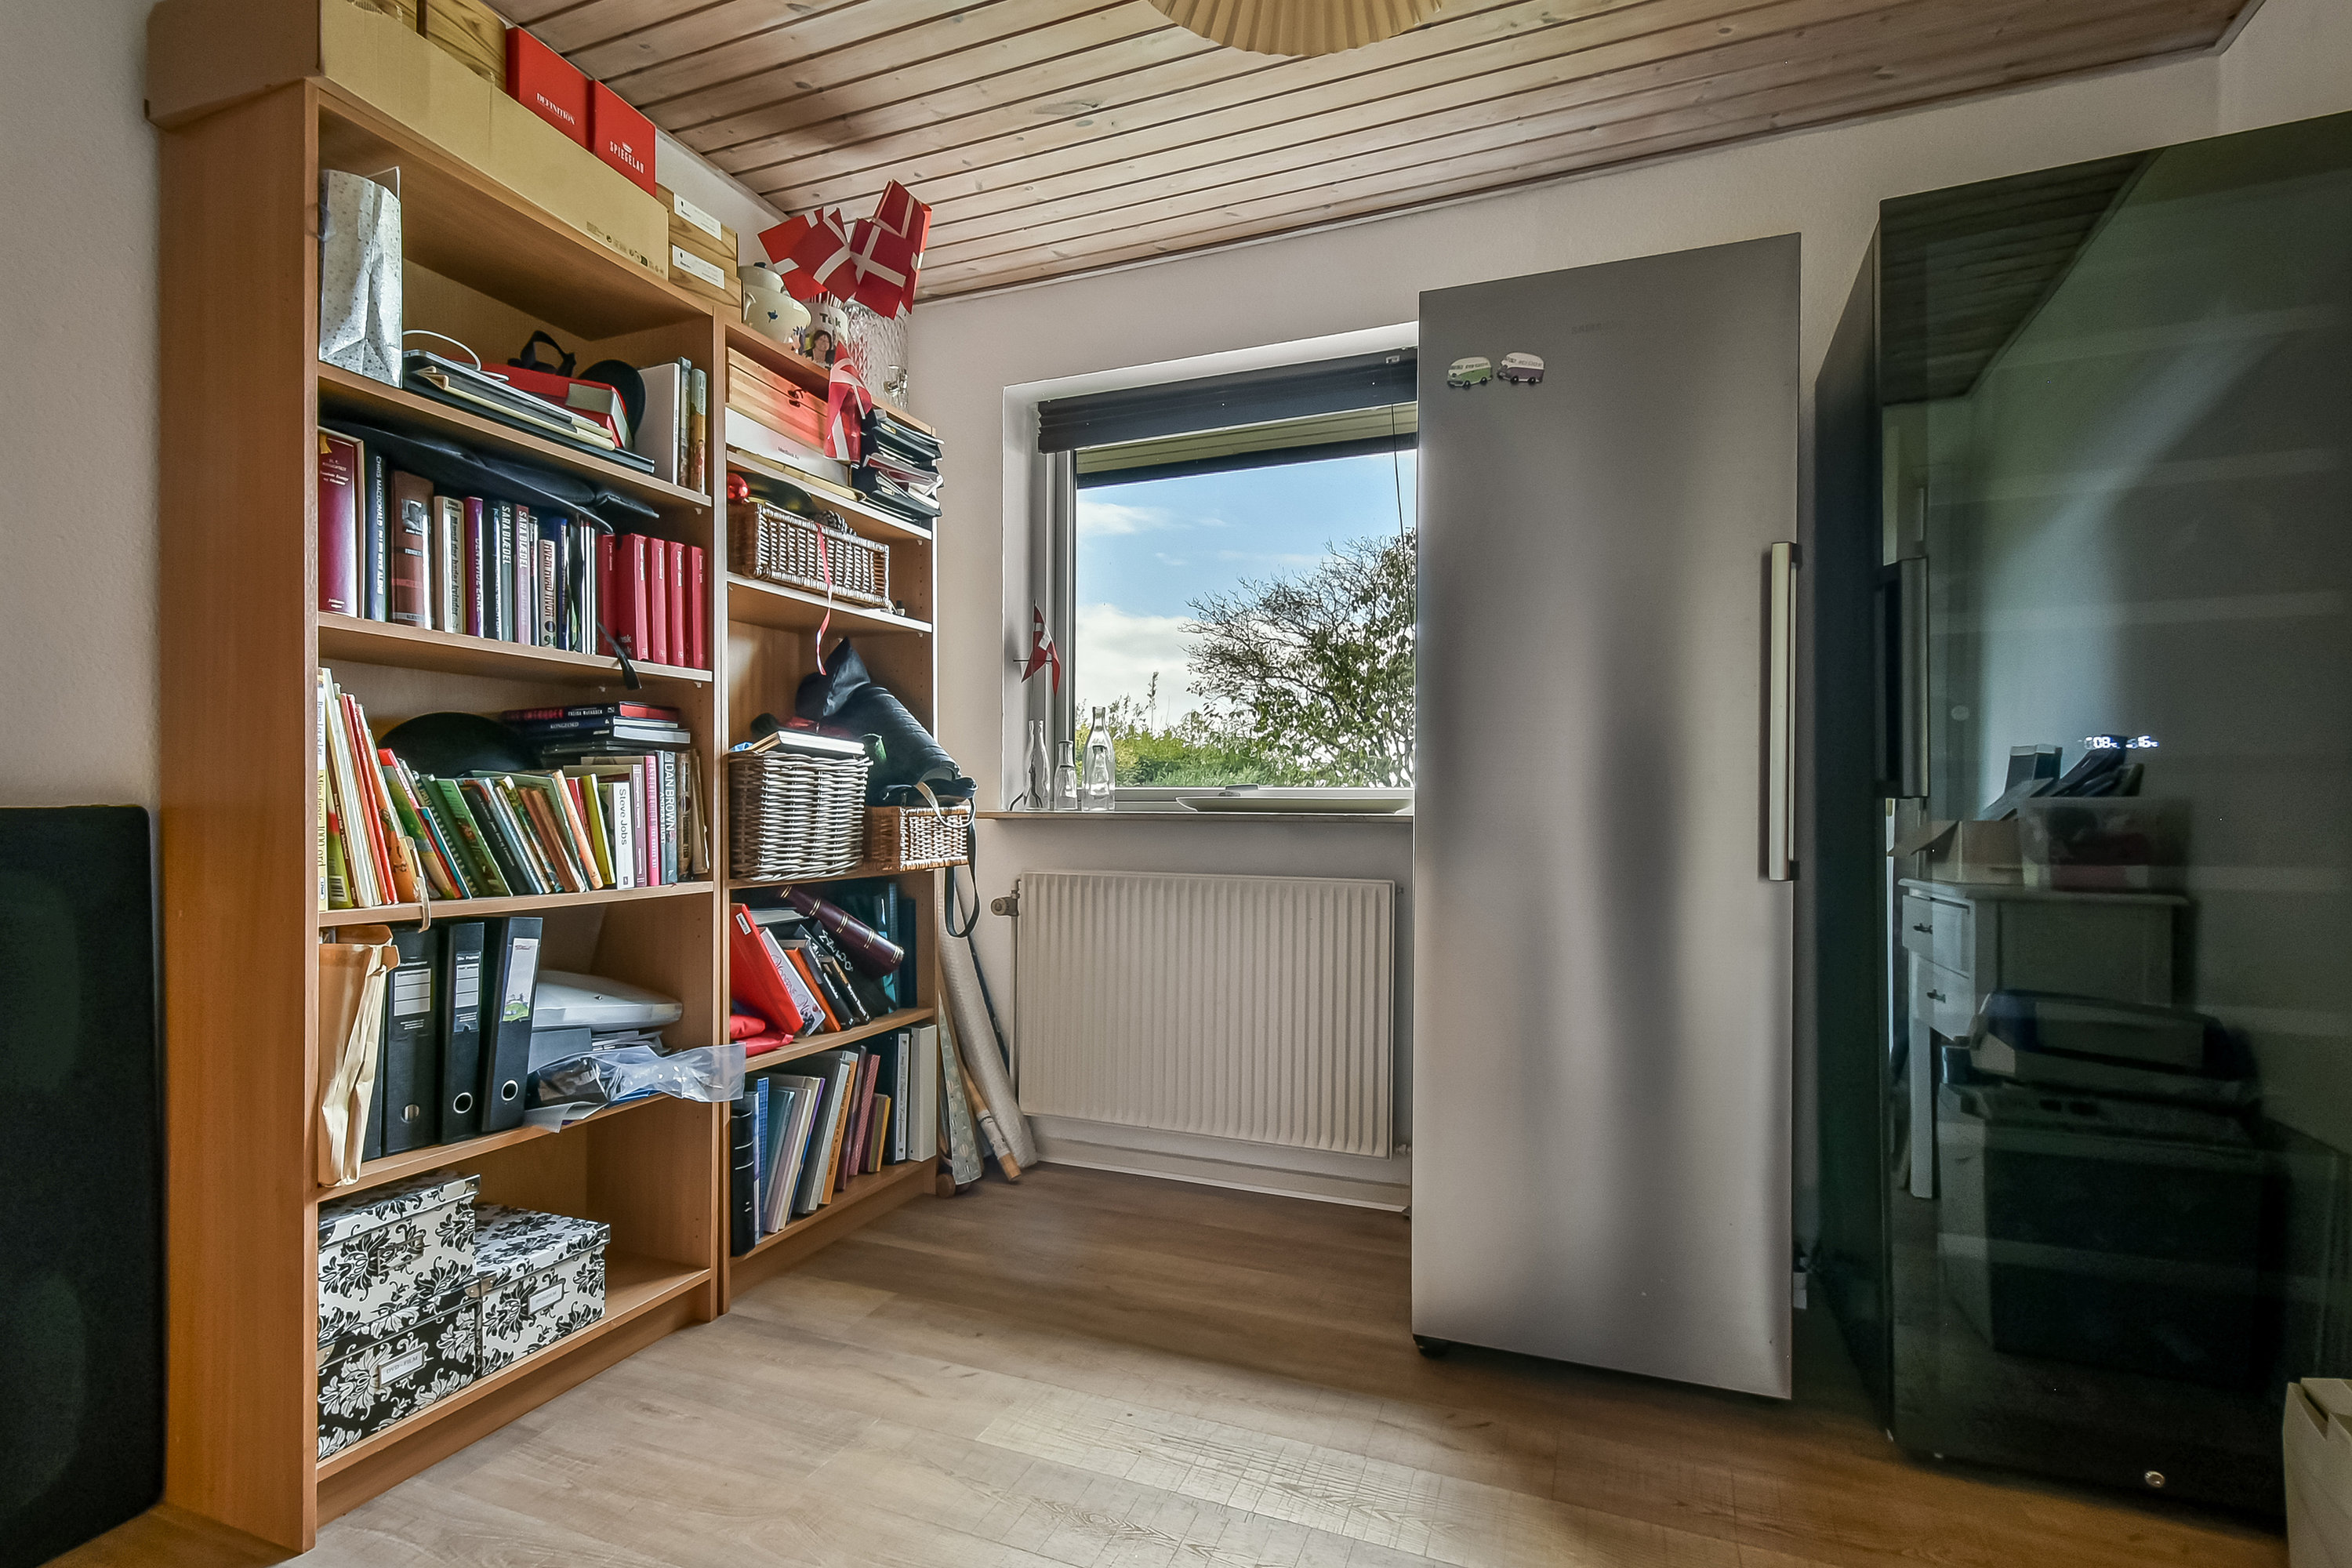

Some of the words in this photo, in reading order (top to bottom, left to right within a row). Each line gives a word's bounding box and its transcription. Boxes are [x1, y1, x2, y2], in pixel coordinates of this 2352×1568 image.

[536, 93, 575, 125] DEFINITION
[610, 140, 644, 174] SPIEGELAU
[502, 506, 510, 530] SARA
[518, 510, 527, 535] SARA
[502, 530, 512, 565] BLÆDEL
[519, 535, 528, 569] BLÆDEL
[544, 544, 553, 568] HVEM
[544, 569, 554, 592] HVAD
[544, 594, 554, 617] HVOR
[664, 763, 673, 787] DAN
[619, 788, 627, 818] Steve
[665, 789, 676, 831] BROWN
[386, 1365, 399, 1374] DVD
[403, 1356, 418, 1366] FILM
